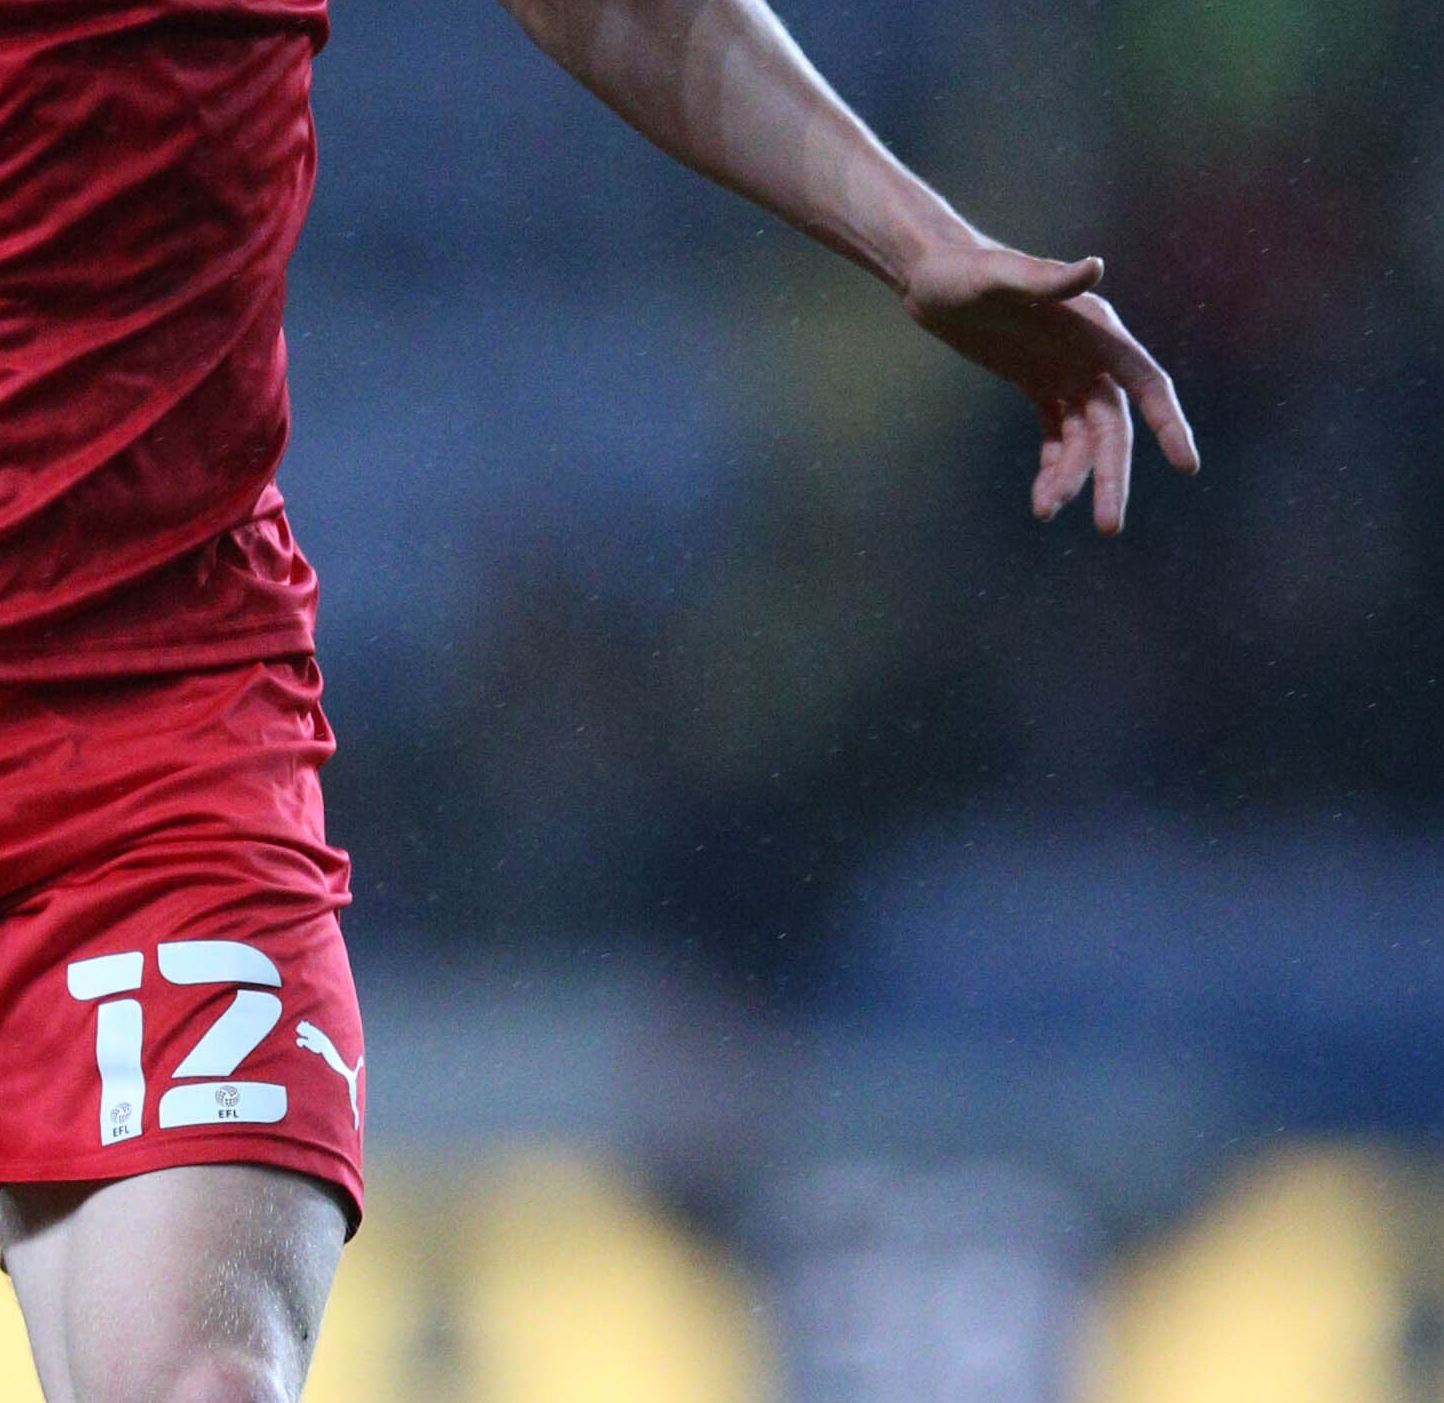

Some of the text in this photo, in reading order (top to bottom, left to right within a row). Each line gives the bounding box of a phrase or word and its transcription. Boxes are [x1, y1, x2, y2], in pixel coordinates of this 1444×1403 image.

[66, 940, 288, 1147] 12
[218, 1109, 239, 1119] EFL
[112, 1125, 130, 1137] EFL
